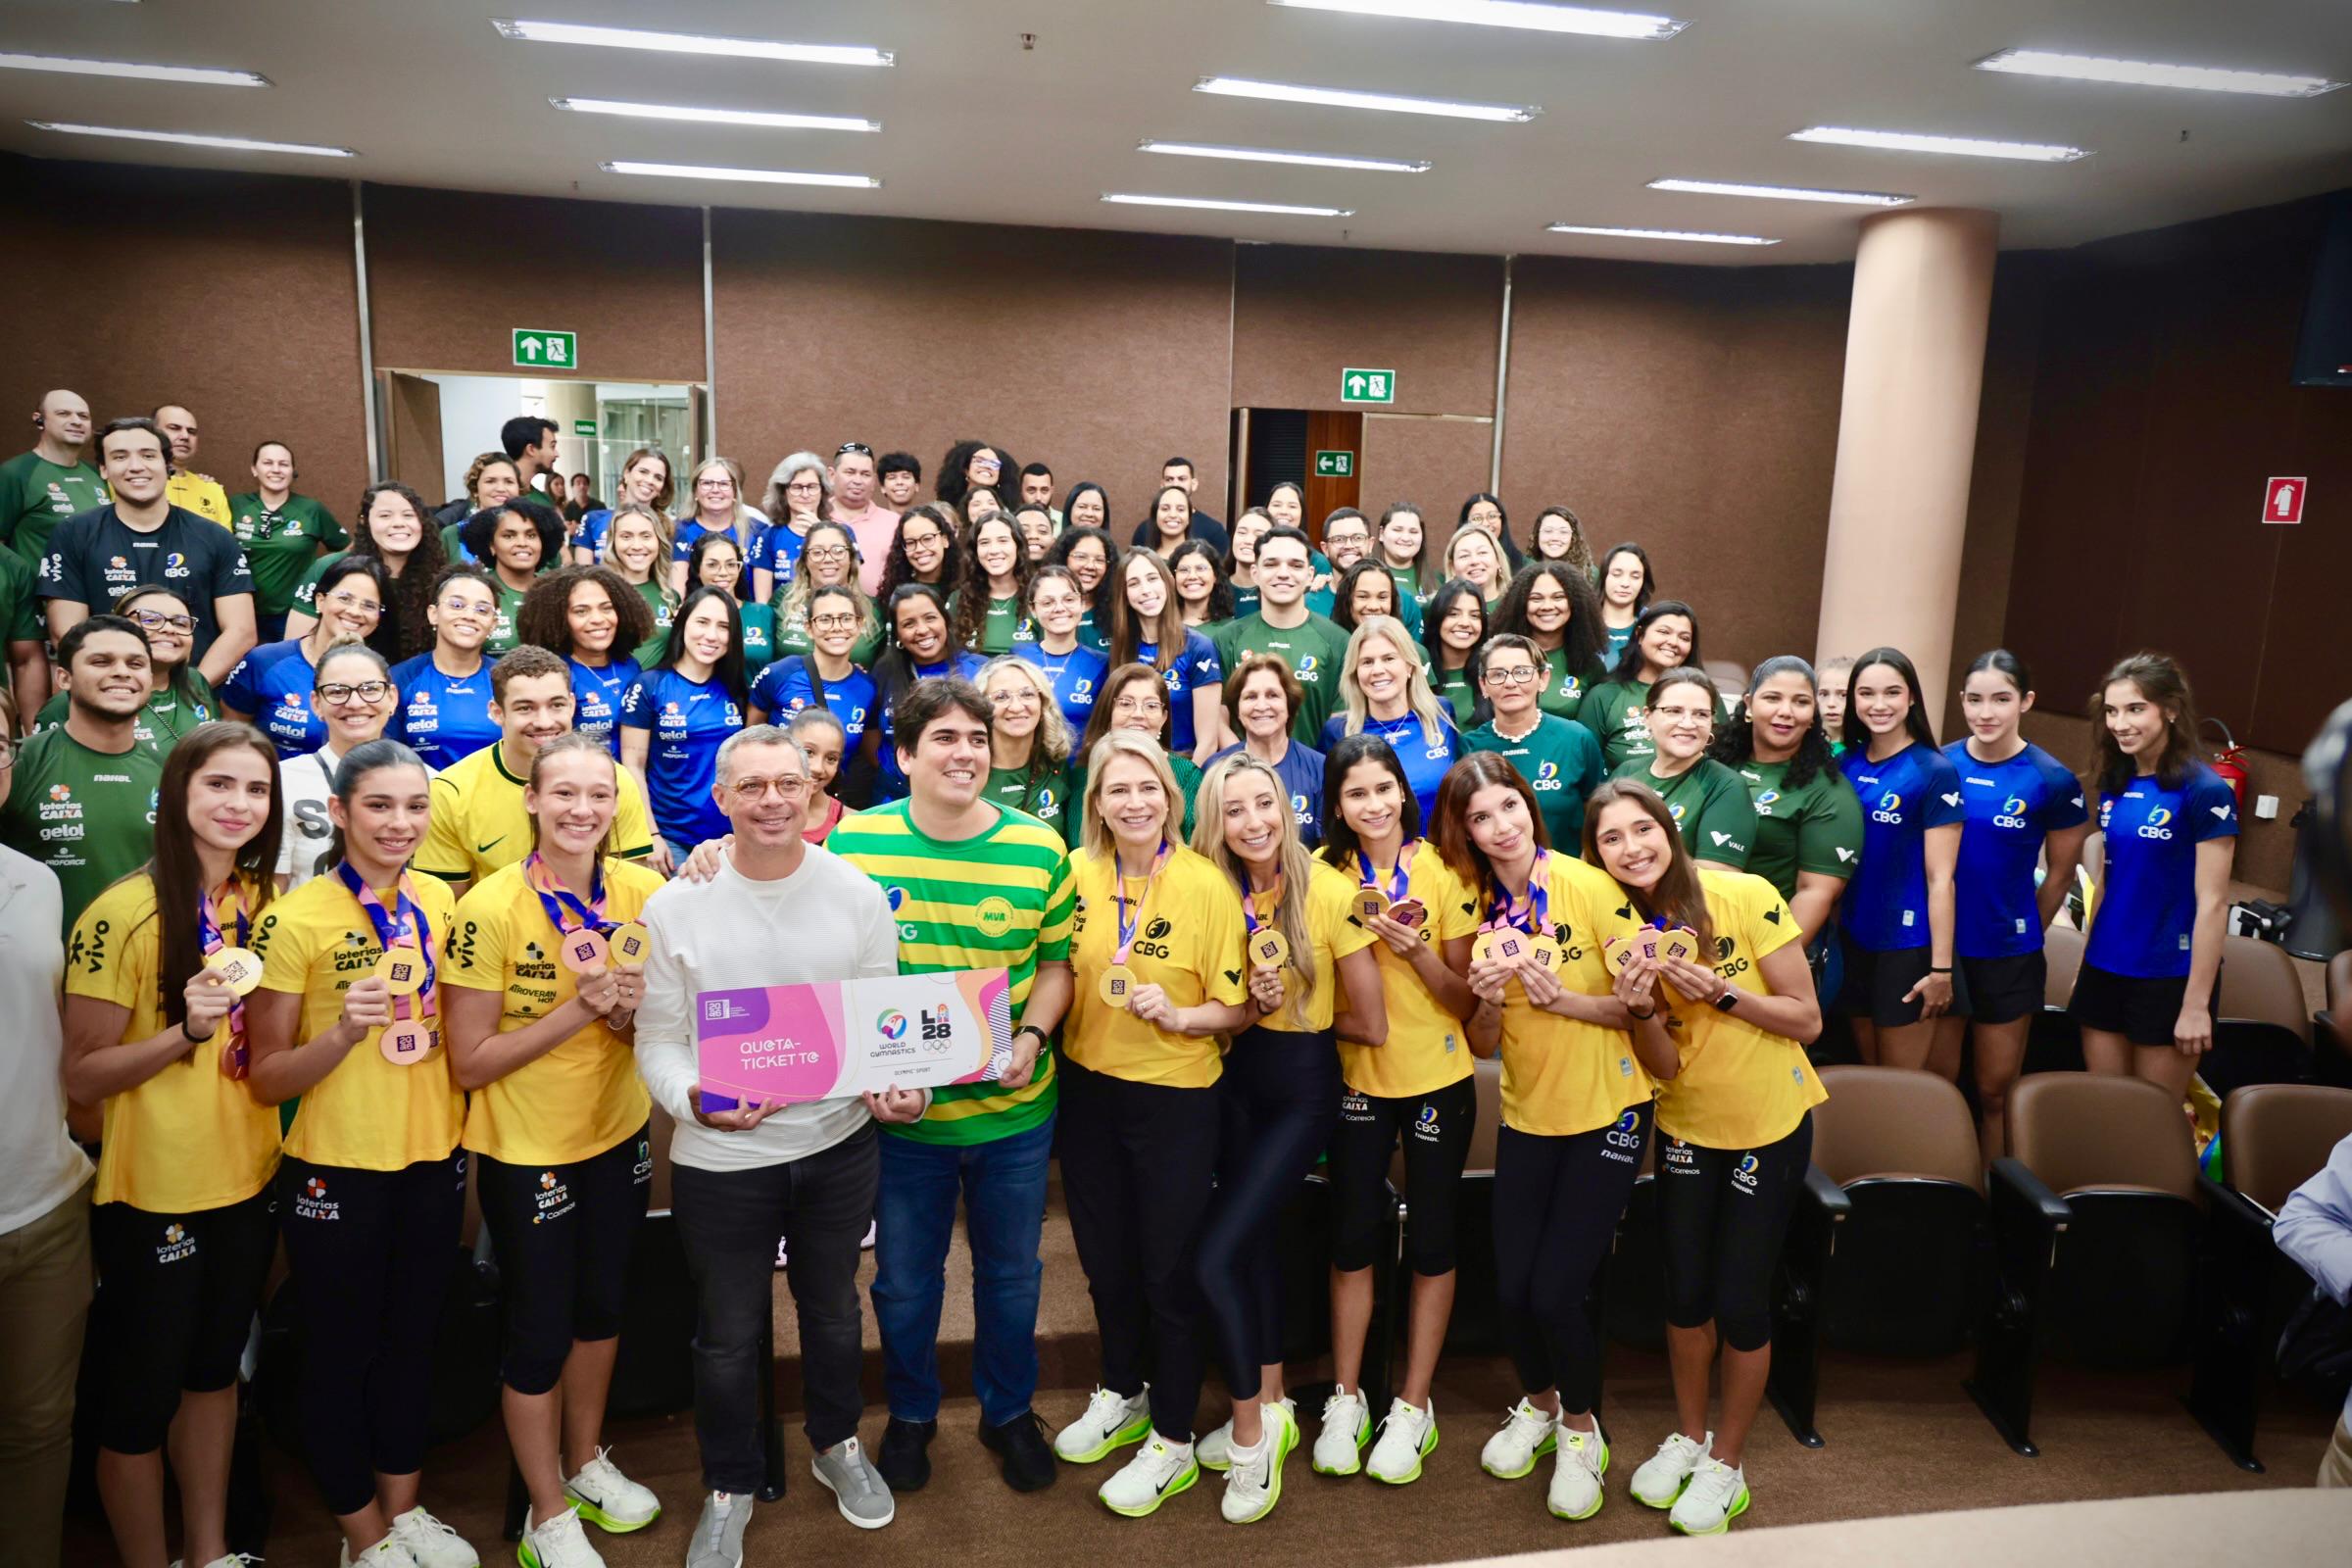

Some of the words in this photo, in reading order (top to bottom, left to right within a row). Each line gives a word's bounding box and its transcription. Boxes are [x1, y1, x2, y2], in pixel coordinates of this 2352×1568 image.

[53, 553, 63, 582] vivo
[165, 566, 190, 577] CBG
[1012, 631, 1033, 641] CBG
[751, 666, 771, 688] vivo
[1294, 669, 1318, 681] CBG
[625, 683, 642, 713] vivo
[1069, 693, 1092, 705] CBG
[1559, 686, 1582, 699] CBG
[270, 721, 307, 737] gelol
[407, 717, 438, 733] gelol
[580, 719, 612, 732] gelol
[1425, 745, 1448, 759] CBG
[1533, 777, 1561, 790] CBG
[39, 802, 82, 811] loterias
[1037, 802, 1058, 818] CBG
[39, 808, 83, 820] CAIXA
[1872, 809, 1902, 824] CBG
[1992, 814, 2026, 828] CBG
[39, 822, 84, 840] gelol
[2137, 824, 2172, 840] CBG
[1728, 840, 1745, 852] VALE
[983, 911, 1005, 922] MVA
[86, 919, 110, 973] vivo
[458, 921, 477, 968] vivo
[1133, 940, 1170, 958] CBG
[334, 946, 382, 960] loterias
[514, 968, 556, 980] CAIXA
[1714, 957, 1748, 979] CBG
[509, 983, 557, 999] ATROVERAN
[538, 995, 554, 1004] HOT
[922, 1023, 951, 1040] 28
[870, 1047, 916, 1058] GYMNASTICS
[879, 1042, 906, 1051] WORLD
[741, 1054, 798, 1071] TICKET
[798, 1052, 820, 1065] TO
[1342, 1102, 1368, 1111] CAIXA
[1346, 1113, 1376, 1122] Correios
[1415, 1120, 1441, 1134] CBG
[1606, 1130, 1640, 1149] CBG
[1666, 1153, 1693, 1163] CAIXA
[1670, 1165, 1700, 1174] Correios
[1733, 1168, 1758, 1187] CBG
[535, 1184, 567, 1201] loterias
[296, 1195, 339, 1209] loterias
[538, 1192, 568, 1208] CAIXA
[296, 1205, 340, 1220] CAIXA
[157, 1237, 195, 1254] loterias
[159, 1246, 196, 1263] CAIXA
